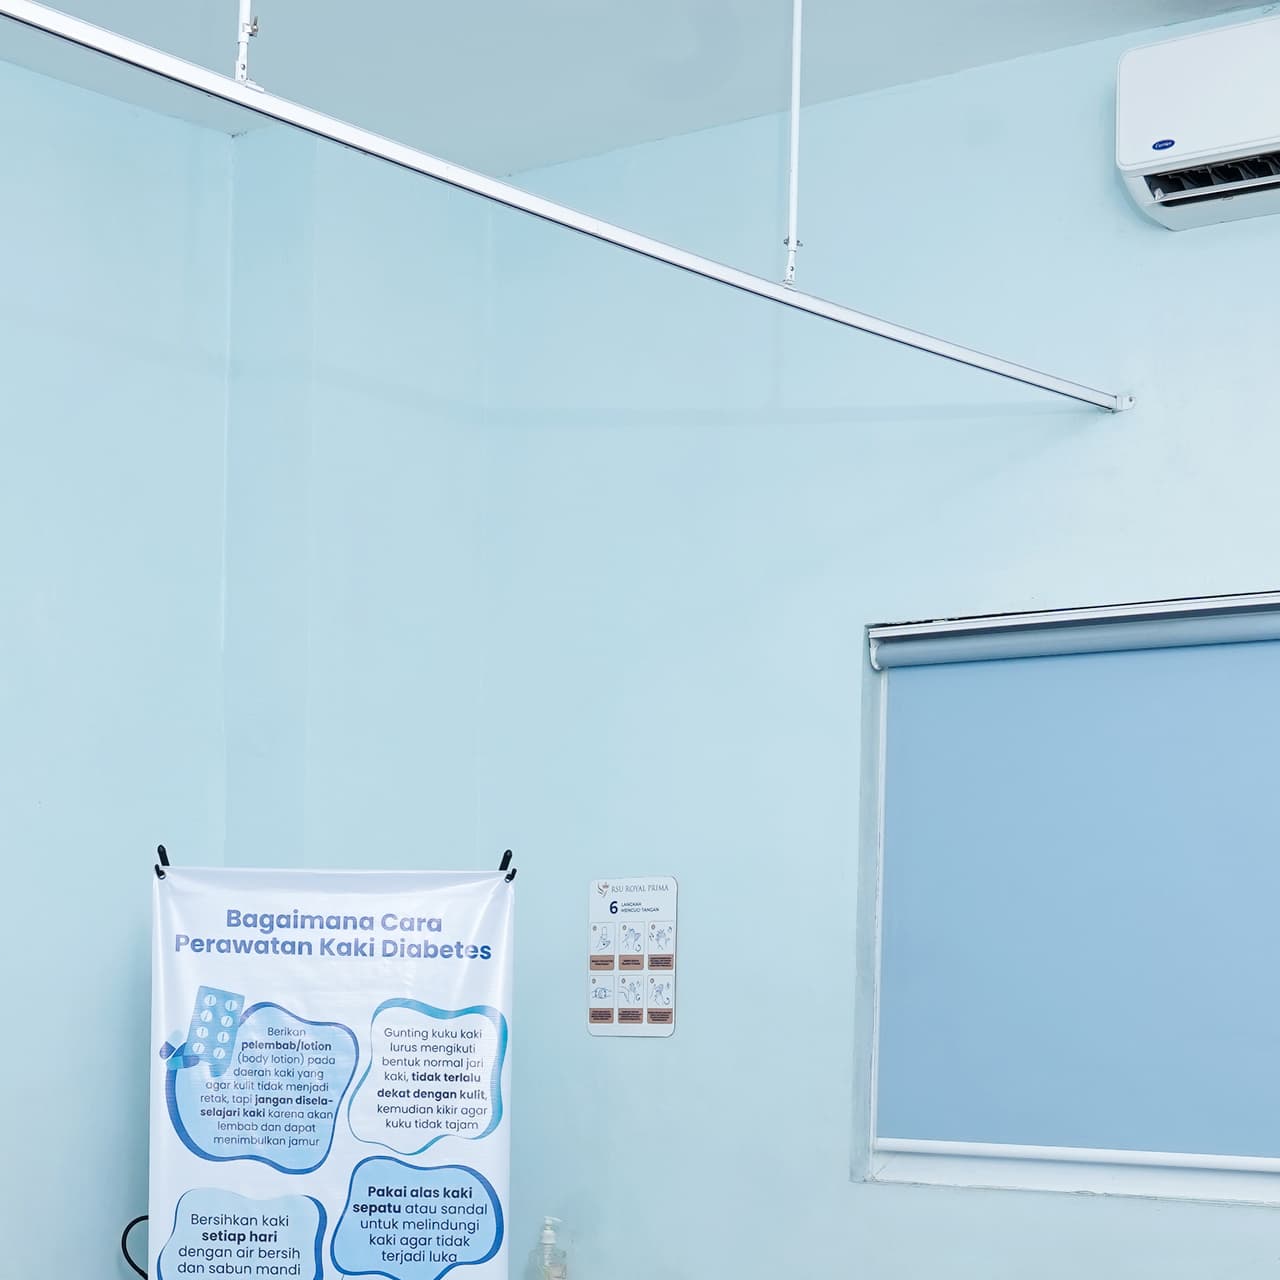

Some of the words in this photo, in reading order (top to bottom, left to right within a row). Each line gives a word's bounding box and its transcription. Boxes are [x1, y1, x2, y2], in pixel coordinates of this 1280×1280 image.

[610, 901, 618, 914] 6
[227, 909, 374, 934] Bagaimana
[381, 914, 442, 932] Cara
[176, 935, 312, 955] Perawatan
[320, 937, 374, 957] Kaki
[382, 939, 491, 960] Diabetes
[384, 1028, 428, 1041] Gunting
[432, 1029, 457, 1038] kuku
[461, 1029, 481, 1039] kaki
[382, 1057, 420, 1067] bentuk
[424, 1058, 463, 1068] normal
[466, 1057, 483, 1070] jari
[412, 1072, 441, 1081] tidak
[444, 1073, 480, 1082] terlalu
[368, 1186, 406, 1197] Pakai
[410, 1187, 439, 1198] alas
[444, 1187, 472, 1198] kaki
[353, 1203, 401, 1216] sepatu
[405, 1204, 436, 1214] atau
[441, 1203, 487, 1215] sandal
[191, 1214, 257, 1226] Bersihkan
[263, 1215, 288, 1226] kaki
[361, 1218, 398, 1229] untuk
[403, 1219, 479, 1234] melindungi
[202, 1230, 246, 1245] setiap
[250, 1231, 277, 1242] hari
[370, 1234, 395, 1245] kaki
[400, 1237, 432, 1249] agar
[437, 1235, 470, 1247] tidak
[179, 1246, 232, 1261] dengan
[236, 1249, 254, 1258] air
[259, 1247, 300, 1259] bersih
[382, 1250, 425, 1264] terjadi
[429, 1251, 457, 1263] luka
[178, 1262, 204, 1273] dan
[209, 1263, 251, 1274] sabun
[256, 1264, 300, 1275] mandi
